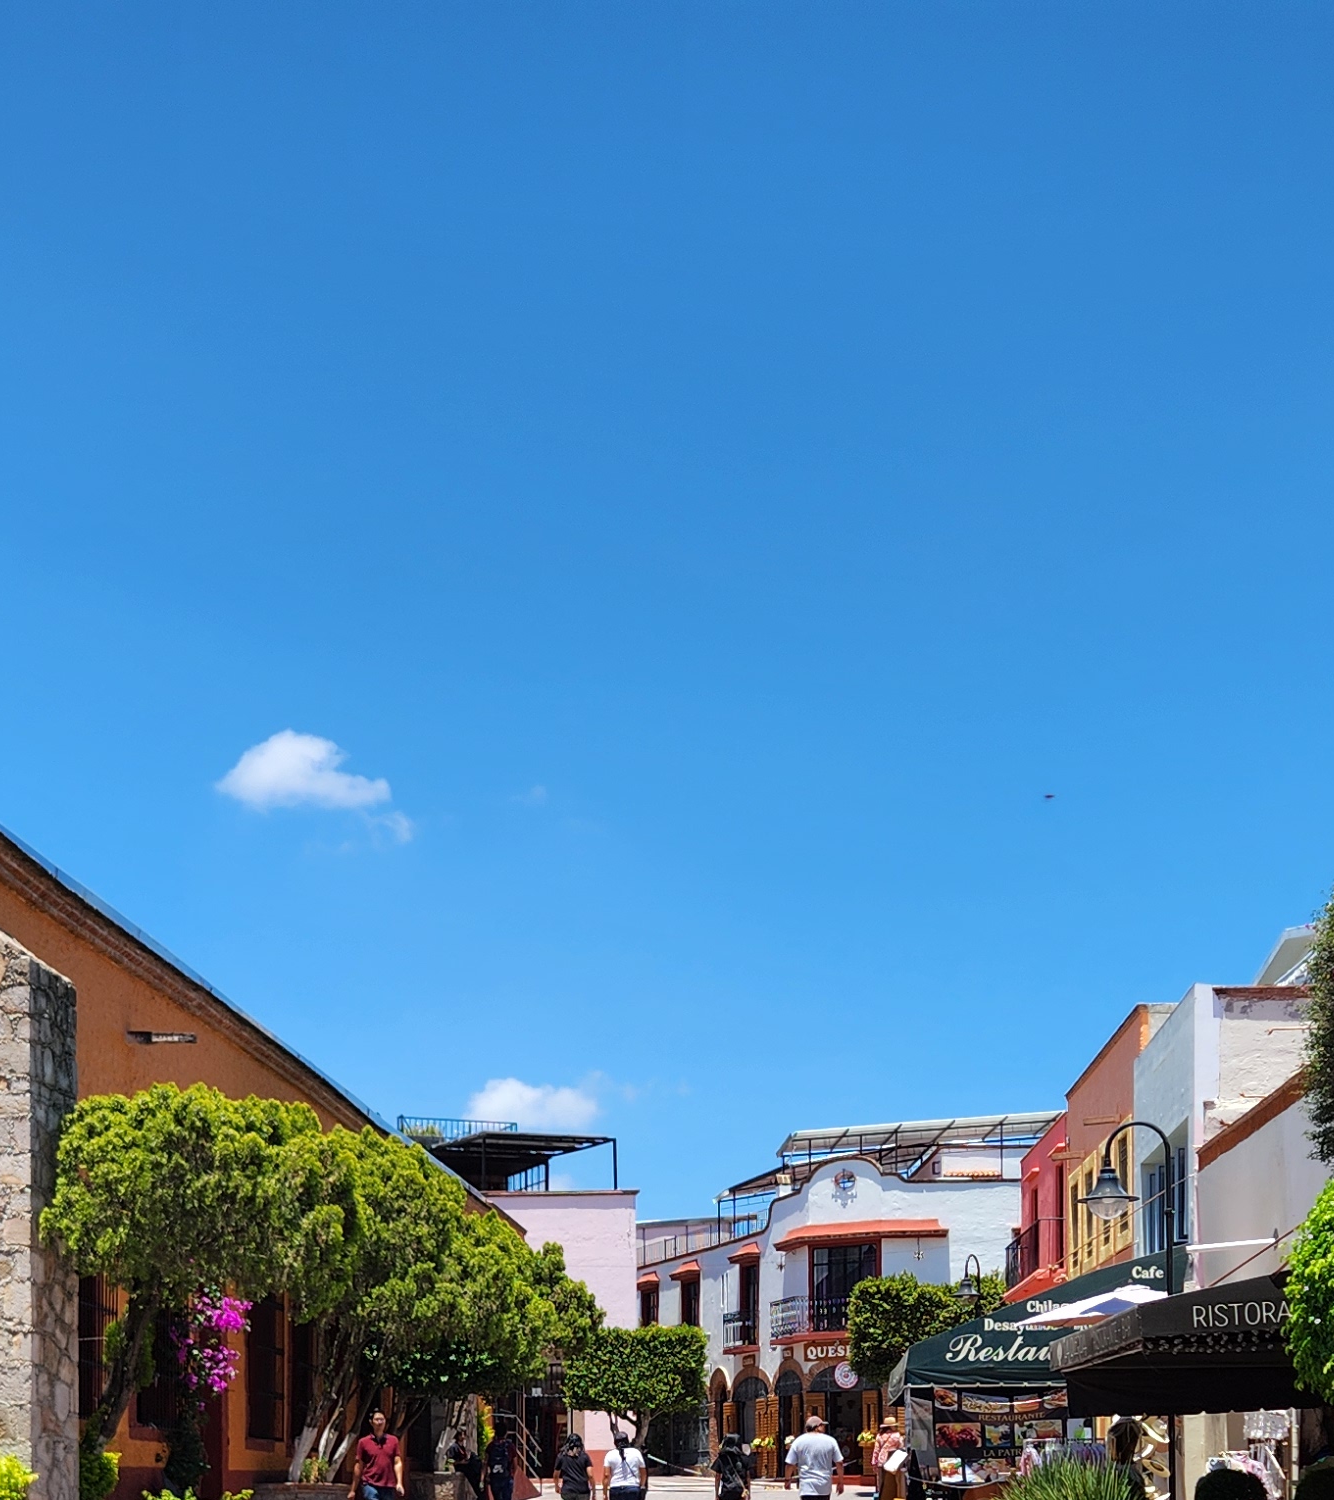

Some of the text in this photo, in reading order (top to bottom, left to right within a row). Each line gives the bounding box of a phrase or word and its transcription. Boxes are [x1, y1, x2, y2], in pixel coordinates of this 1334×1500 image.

[1132, 1265, 1164, 1279] Cafe
[978, 1412, 1045, 1421] RESTAURANTE
[983, 1449, 996, 1457] LA
